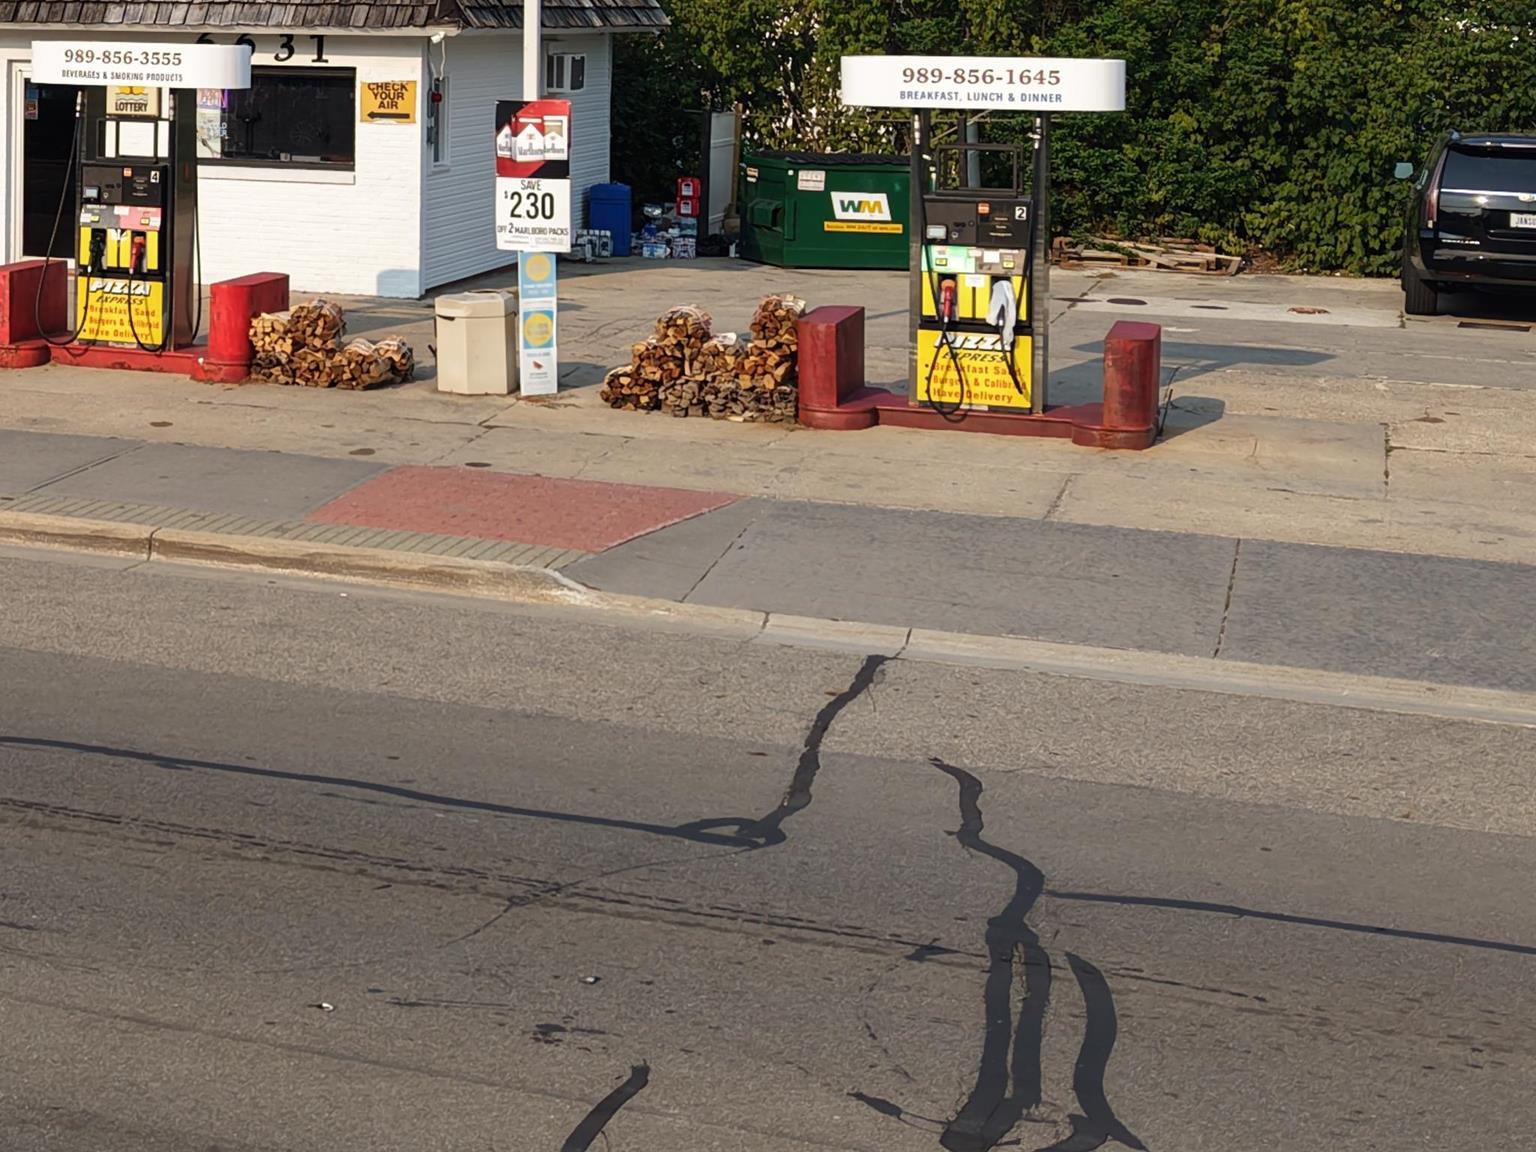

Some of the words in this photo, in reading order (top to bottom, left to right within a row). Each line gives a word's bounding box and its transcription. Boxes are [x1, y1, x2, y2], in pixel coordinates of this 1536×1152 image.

[64, 49, 182, 66] 989-856-3555
[62, 69, 100, 79] BEVERAGES
[111, 72, 144, 80] SMOKING
[147, 73, 183, 82] PRODUCTS
[902, 67, 1061, 85] 989-856-1645
[367, 82, 409, 92] CHECK
[373, 91, 405, 100] YOUR
[899, 91, 963, 102] BREAKFAST,
[967, 92, 1003, 102] LUNCH
[1008, 93, 1015, 102] &
[1020, 93, 1063, 103] DINNER
[115, 102, 148, 112] LOTTERY
[378, 100, 399, 109] AIR
[152, 171, 158, 181] 4
[521, 179, 542, 191] SAVE
[839, 200, 883, 213] WM
[1017, 208, 1024, 218] 2
[508, 222, 514, 233] 2
[515, 226, 547, 235] MARLBORO
[549, 227, 569, 236] PACKS
[89, 278, 151, 297] PIZZA
[89, 305, 131, 315] Breakfas
[934, 332, 1011, 351] PIZZ
[974, 378, 980, 386] &
[966, 389, 1013, 403] Delivery
